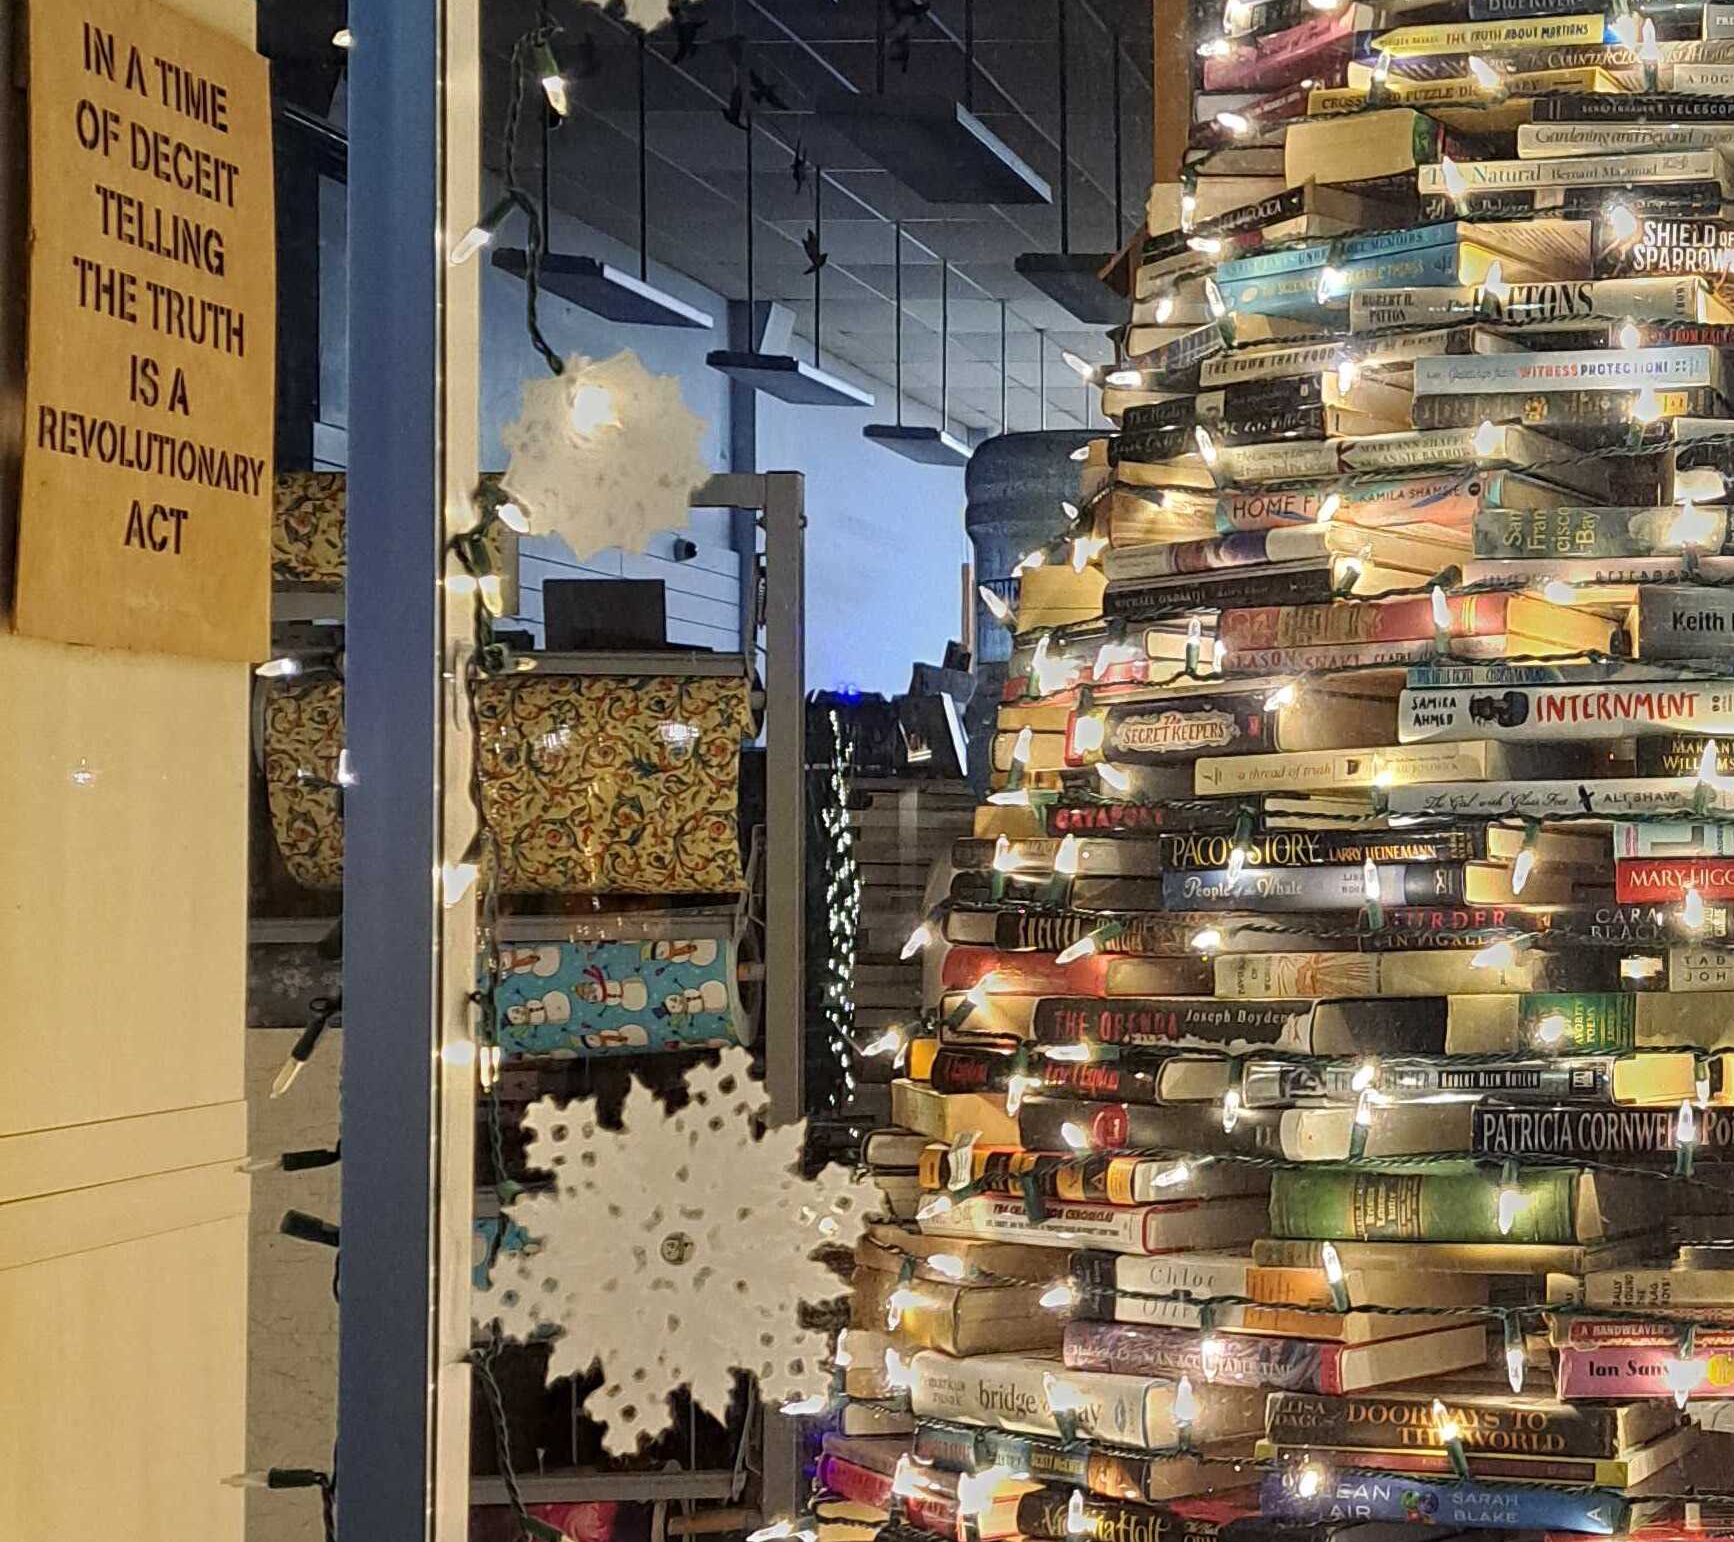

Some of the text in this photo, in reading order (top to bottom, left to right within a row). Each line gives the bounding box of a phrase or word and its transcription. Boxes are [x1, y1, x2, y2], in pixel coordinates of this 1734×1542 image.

[1445, 21, 1590, 46] THE TRUTH ABOUT MARTIANS
[81, 21, 229, 135] IN A TIME
[1406, 86, 1454, 104] PUZZLE
[75, 97, 240, 210] OF DECEIT
[1473, 165, 1542, 185] Natural
[94, 182, 226, 279] TELLING
[1642, 220, 1716, 248] SHIELD
[71, 254, 246, 359] THE TRUTH
[1369, 307, 1408, 324] PATTON
[1519, 363, 1578, 379] WITNESS
[128, 352, 192, 418] IS A
[37, 403, 266, 498] REVOLUTIONARY
[1232, 494, 1296, 519] HOME
[123, 498, 191, 558] ACT
[1672, 610, 1725, 633] Keith
[1413, 710, 1455, 727] AHMED
[1536, 691, 1699, 724] INTERNMENT
[1122, 723, 1225, 746] SECRET KEEPERS
[1247, 832, 1322, 864] STORY
[1630, 870, 1684, 887] MARY
[1483, 1110, 1572, 1152] PATRICIA
[1588, 1358, 1620, 1378] Ian
[977, 1379, 1038, 1416] bridge
[1346, 1402, 1548, 1431] DOORWAYS TO
[1450, 1491, 1519, 1506] SARAH
[1453, 1510, 1520, 1525] BLAKE
